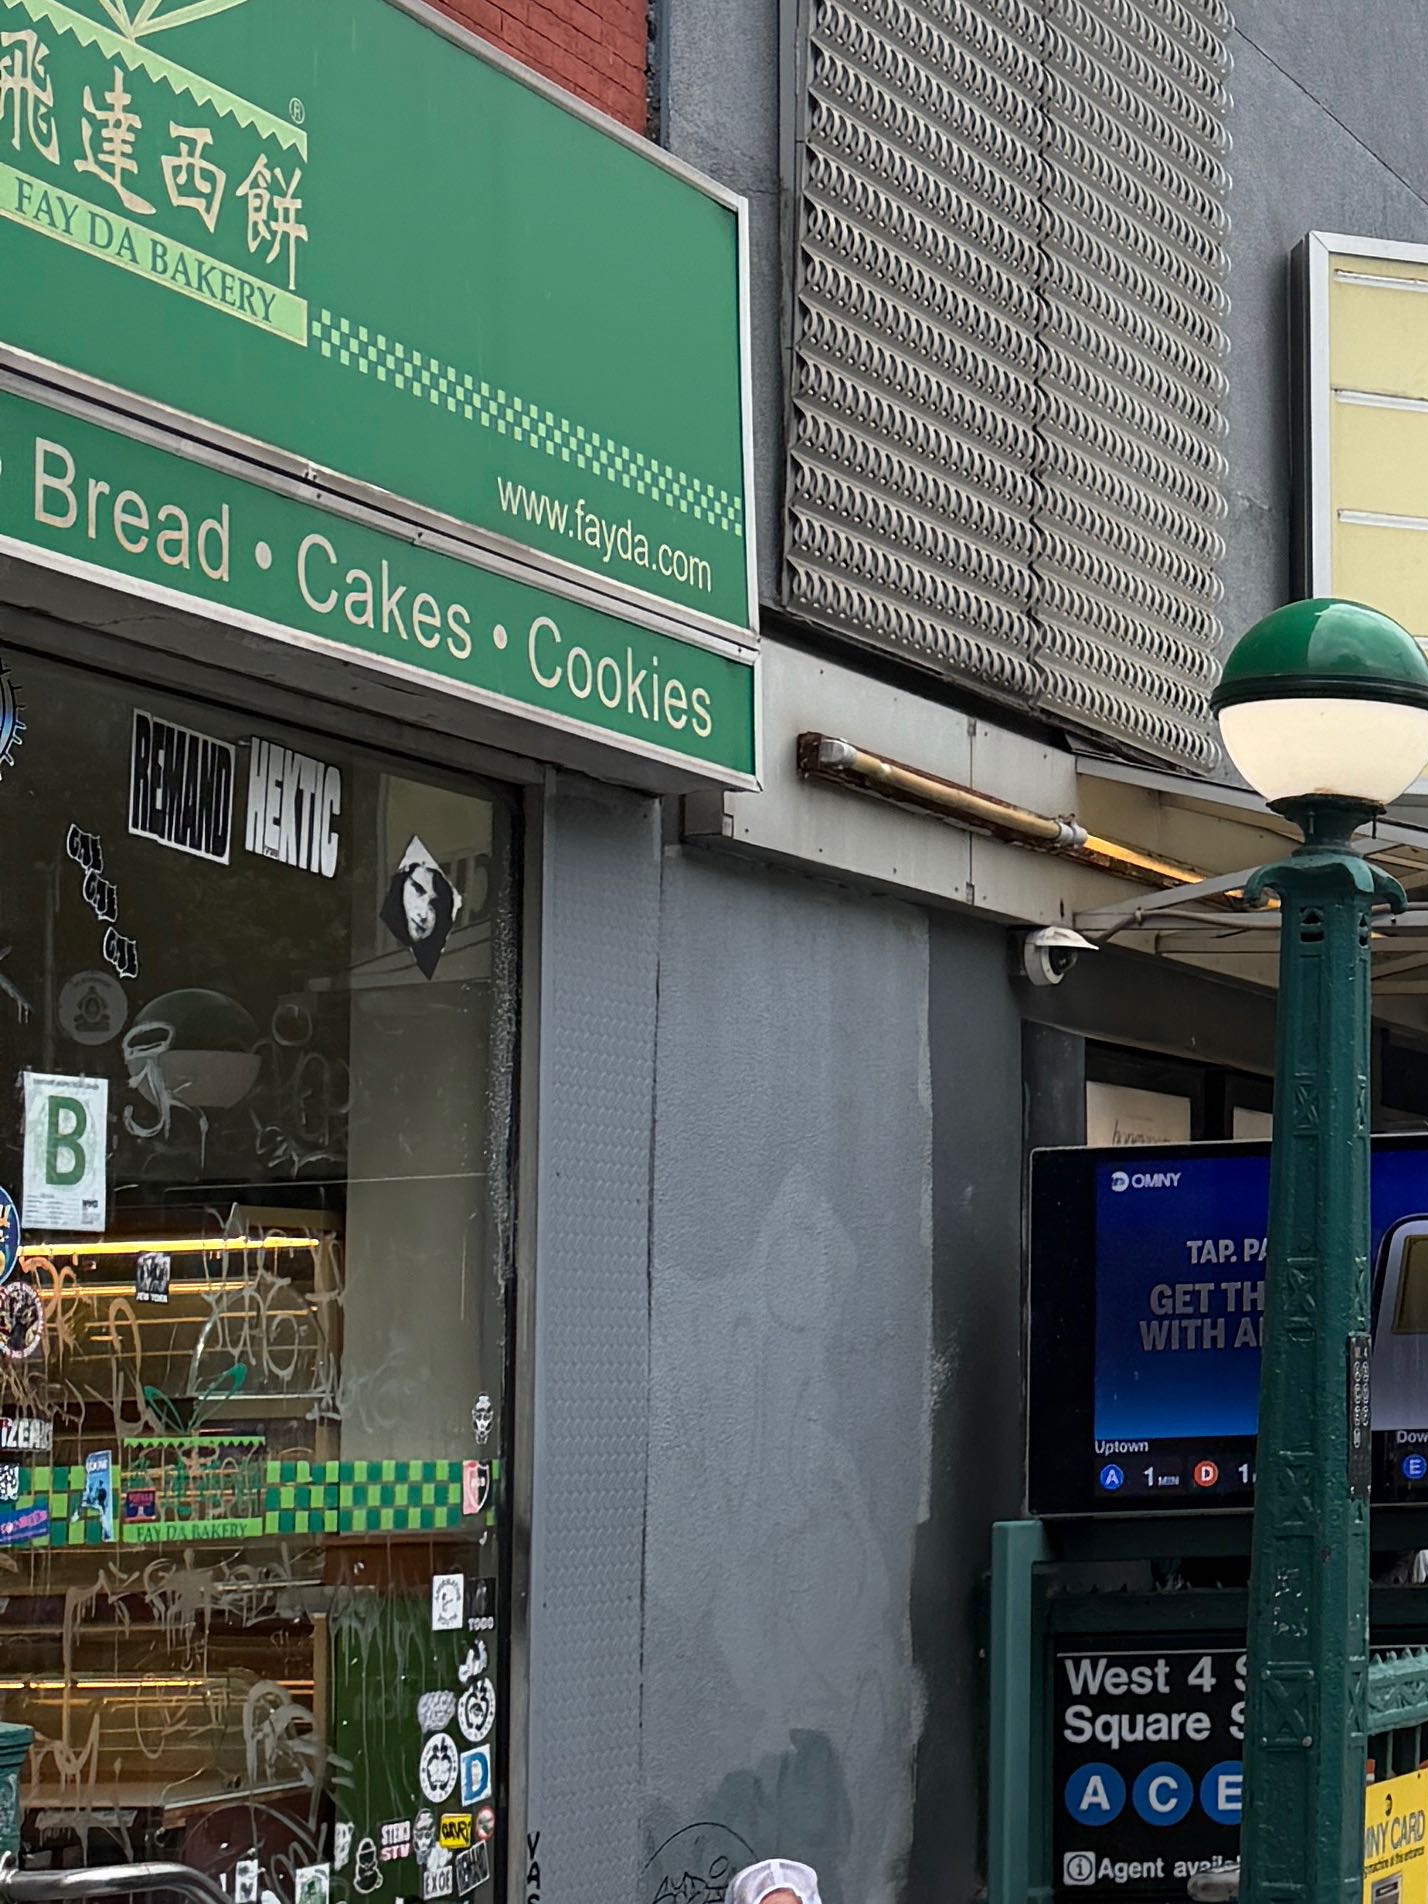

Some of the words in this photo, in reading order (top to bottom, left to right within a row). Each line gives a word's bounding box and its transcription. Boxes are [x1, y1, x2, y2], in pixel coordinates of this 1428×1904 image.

[15, 177, 78, 235] FAY
[88, 211, 139, 265] DA
[150, 240, 276, 323] BAKERY
[498, 477, 712, 593] www.fayda.com
[34, 436, 231, 583] Bread
[297, 533, 473, 661] Cakes
[528, 616, 712, 738] Cookies
[245, 736, 341, 878] HEKTIC
[46, 1095, 87, 1185] B
[1131, 1172, 1182, 1189] OMNY
[1186, 1238, 1238, 1265] TAP.
[1150, 1282, 1215, 1316] GET
[1220, 1280, 1265, 1313] TH
[1139, 1317, 1226, 1352] WITH
[1095, 1440, 1149, 1456] Uptown
[1144, 1466, 1154, 1487] 1
[1238, 1463, 1249, 1484] 1
[192, 1523, 248, 1540] BAKERY
[1064, 1658, 1171, 1696] West
[1187, 1656, 1217, 1693] 4
[1063, 1704, 1212, 1750] Square
[1079, 1775, 1111, 1811] A
[1148, 1775, 1178, 1813] C
[1217, 1774, 1243, 1811] E
[1390, 1809, 1426, 1850] CARD
[1098, 1857, 1165, 1883] Agent
